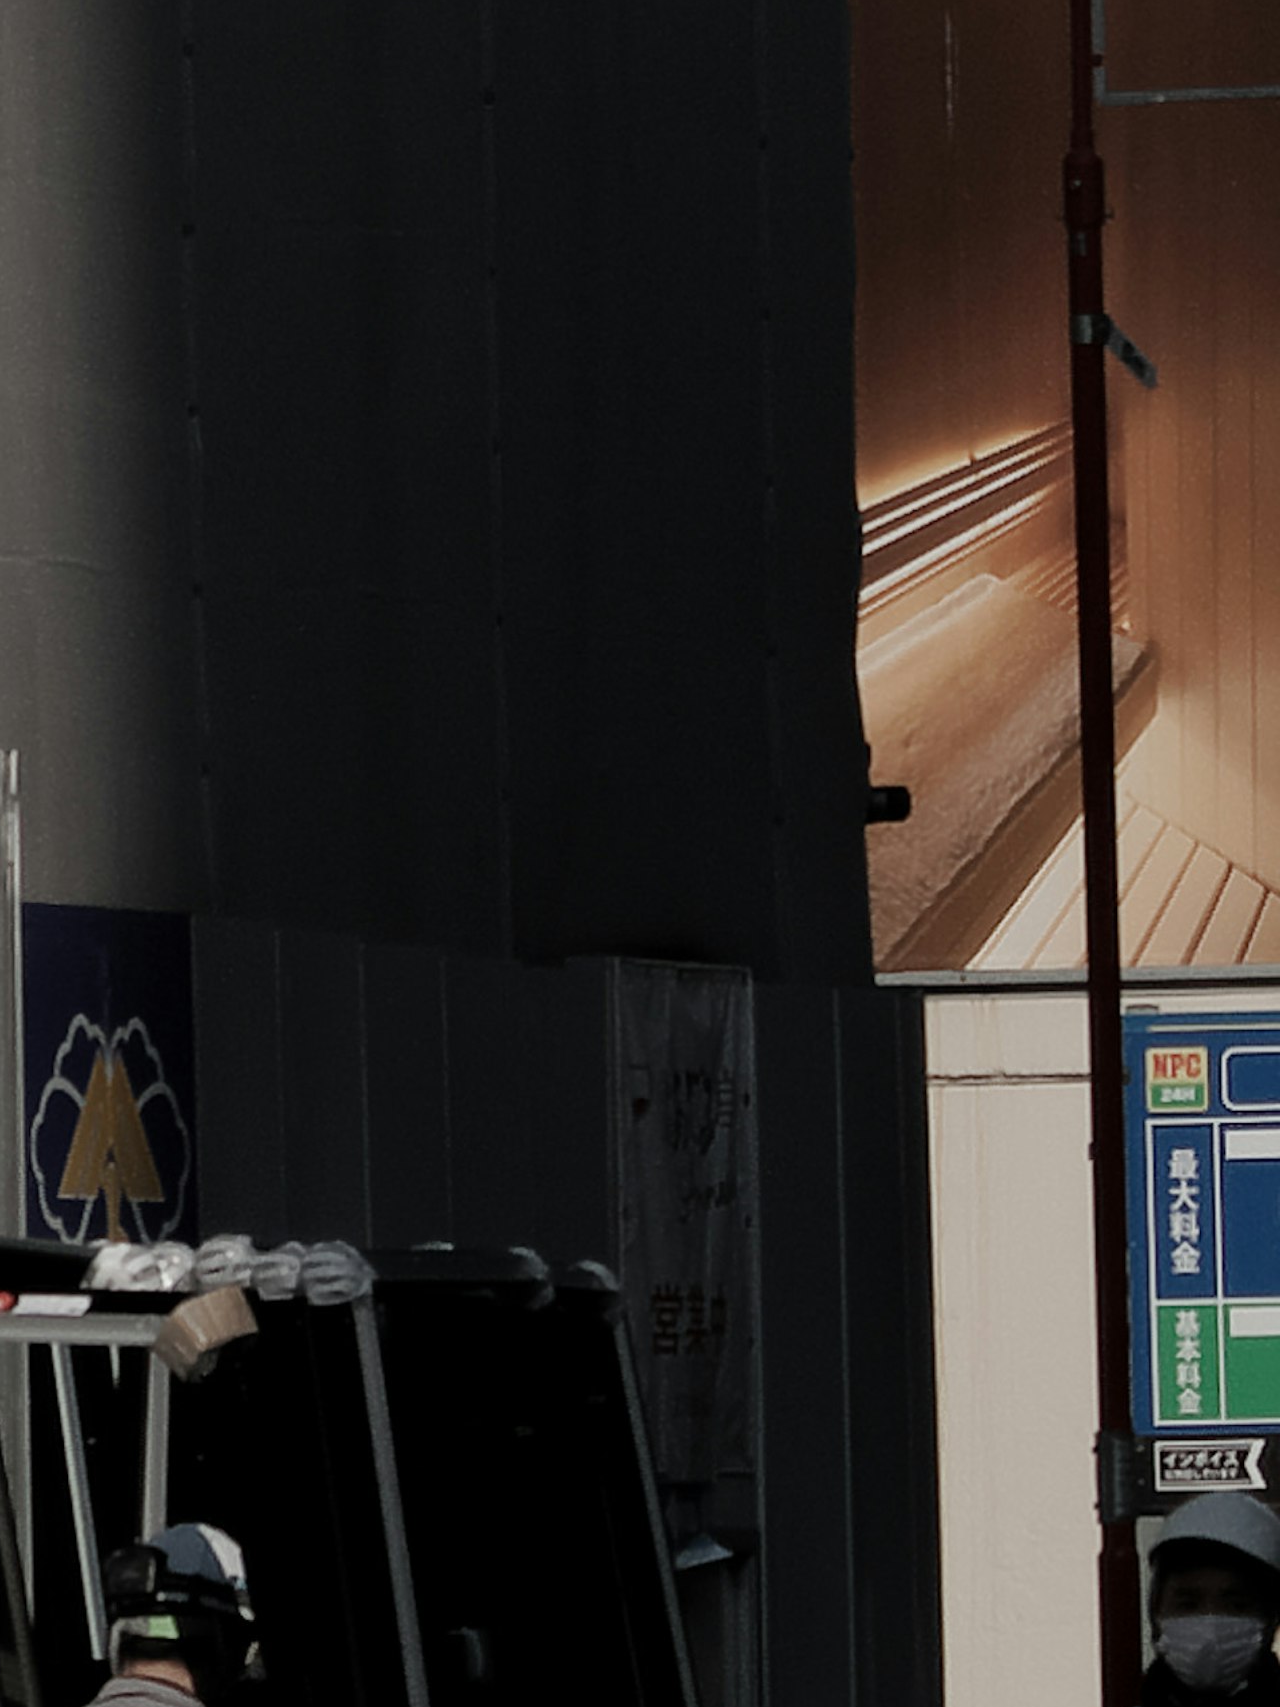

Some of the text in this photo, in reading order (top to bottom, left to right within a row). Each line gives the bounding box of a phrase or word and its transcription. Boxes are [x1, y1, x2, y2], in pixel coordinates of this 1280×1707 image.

[1152, 1053, 1202, 1078] NPC
[1167, 1147, 1202, 1275] 最大料金
[1174, 1309, 1203, 1416] 基本料金
